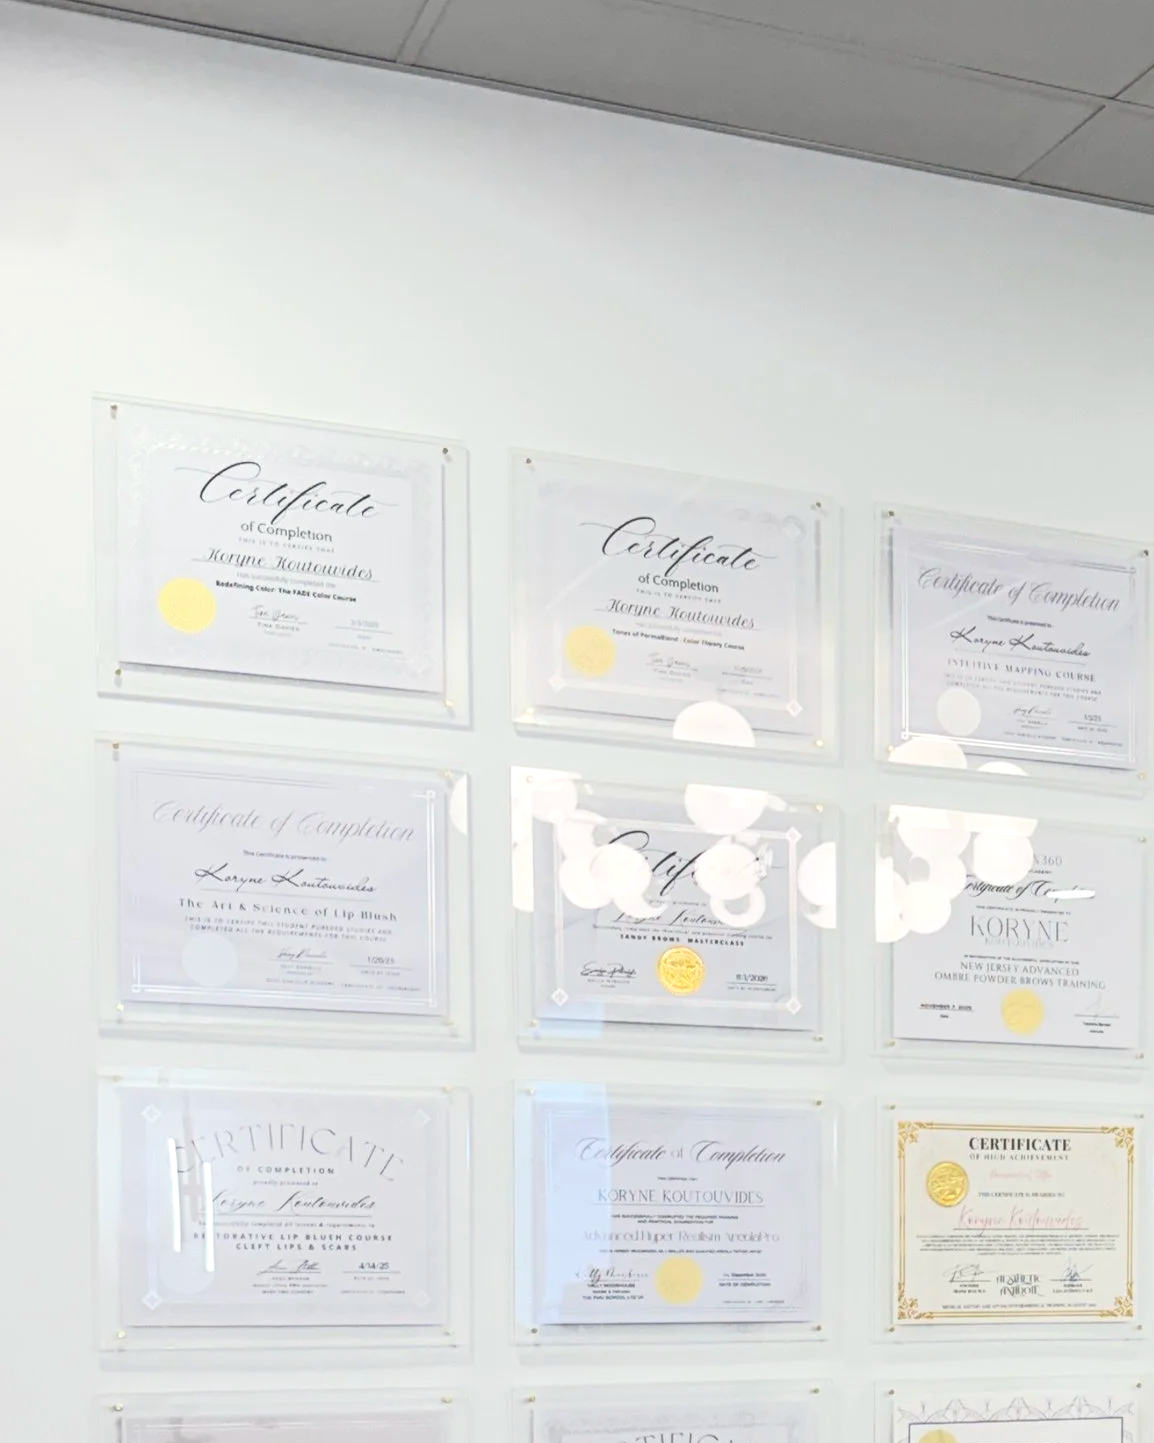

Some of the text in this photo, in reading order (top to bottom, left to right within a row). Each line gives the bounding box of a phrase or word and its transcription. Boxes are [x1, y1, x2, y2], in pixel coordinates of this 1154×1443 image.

[174, 461, 399, 525] Certificate
[240, 521, 333, 543] of Completion
[578, 516, 778, 577] Certificate
[638, 574, 719, 593] of Completion
[918, 567, 1120, 612] Certificate of Completion
[1055, 671, 1096, 683] COURSE
[152, 800, 416, 842] Certificate of Completion
[178, 897, 204, 909] The
[211, 900, 233, 911] Art
[252, 902, 309, 916] Science
[314, 907, 329, 918] of
[333, 908, 356, 921] Lip
[361, 910, 398, 922] Blush
[971, 915, 1069, 942] KORYNE
[960, 961, 1079, 976] NEW JERSEY ADVANCED
[1057, 979, 1107, 990] TRAINING
[690, 1141, 787, 1170] Completion
[968, 1137, 1072, 1152] CERTIFICATE
[969, 1153, 980, 1161] OF
[597, 1188, 764, 1204] KORYNE KOUTOUVIDES
